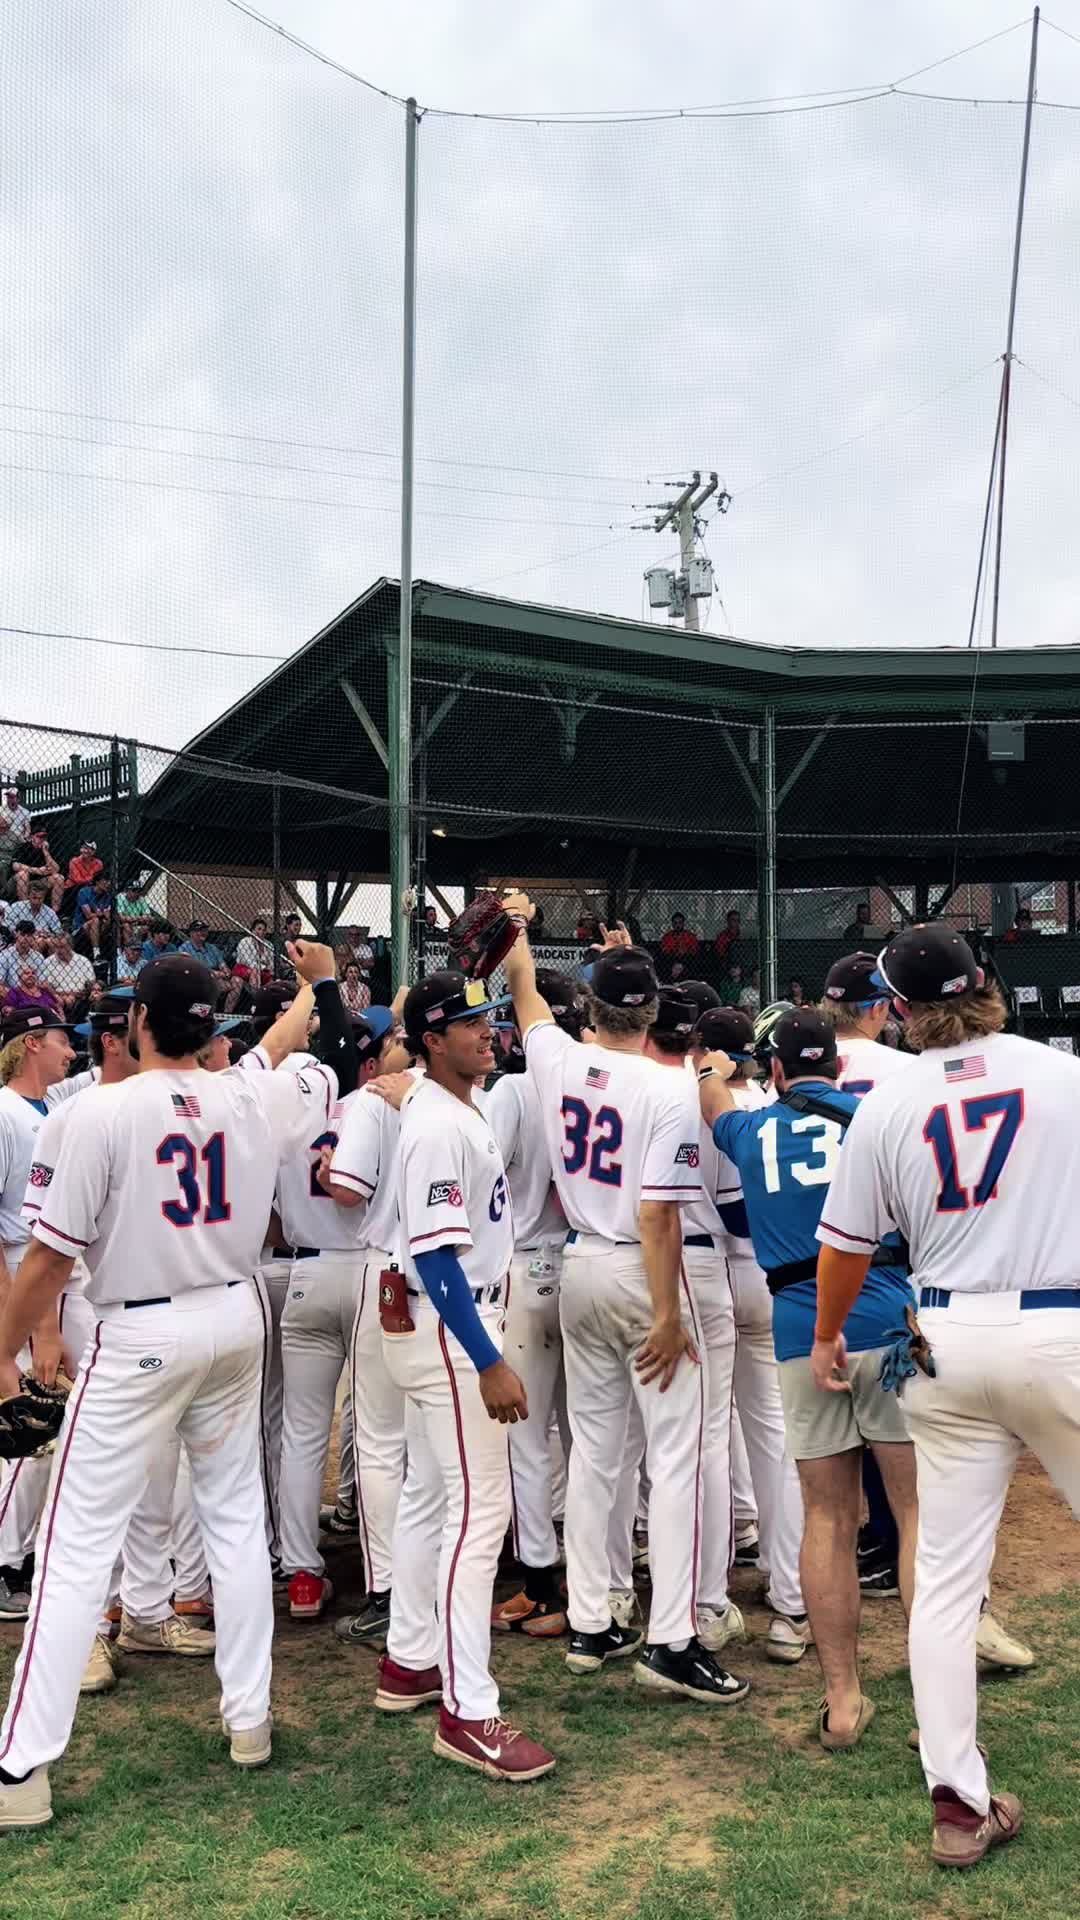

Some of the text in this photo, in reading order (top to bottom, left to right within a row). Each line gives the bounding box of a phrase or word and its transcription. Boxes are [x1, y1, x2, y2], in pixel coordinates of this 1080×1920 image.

[156, 1132, 231, 1227] 31
[560, 1095, 623, 1187] 32
[757, 1114, 841, 1194] 13
[922, 1088, 1024, 1212] 17
